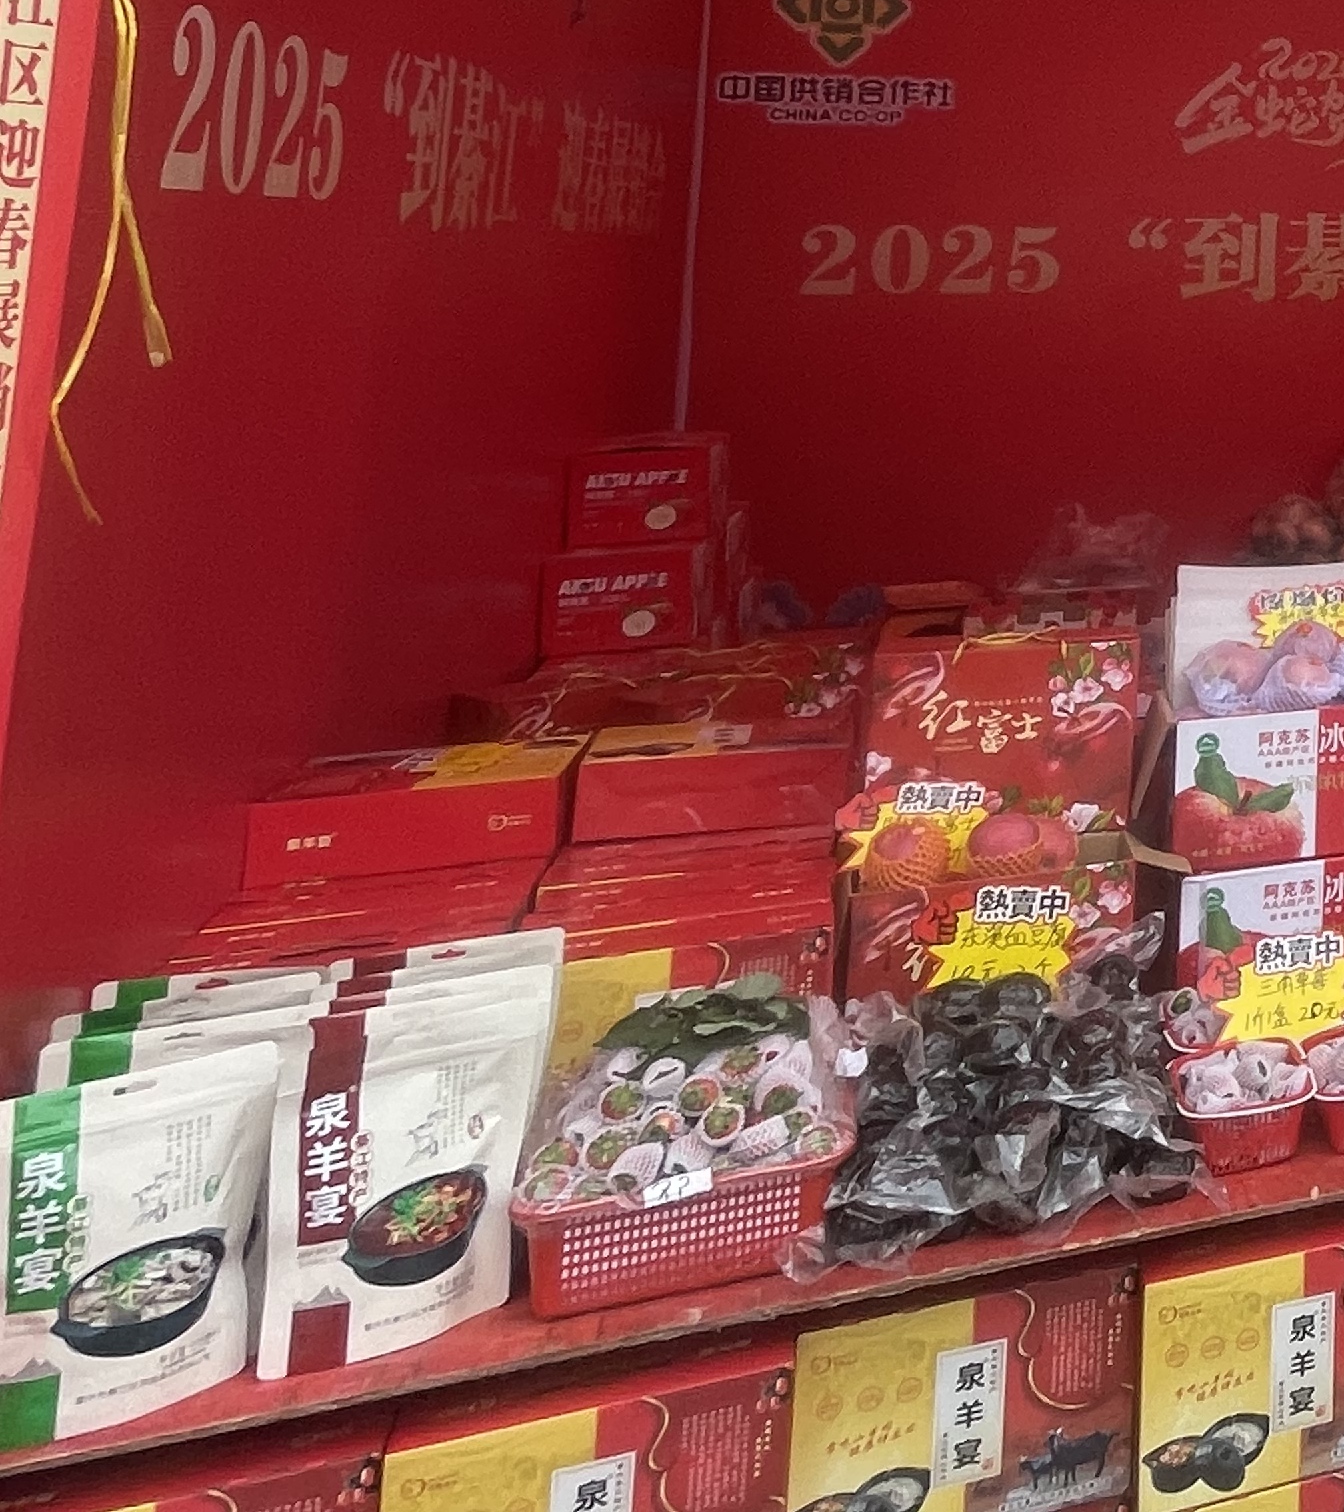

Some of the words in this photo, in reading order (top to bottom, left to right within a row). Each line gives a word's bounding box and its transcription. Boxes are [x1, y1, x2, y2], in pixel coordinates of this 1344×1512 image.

[160, 4, 349, 201] 2025
[717, 73, 954, 109] 中国供销合作社
[799, 223, 1060, 296] 2025
[918, 690, 1043, 754] 红富士
[978, 888, 1067, 919] 熱賣中
[1259, 935, 1340, 970] 熱賣中
[304, 1090, 351, 1229] 泉羊宴
[14, 1151, 67, 1294] 泉羊宴
[1289, 1314, 1317, 1417] 泉羊宴
[950, 1361, 990, 1472] 泉羊宴
